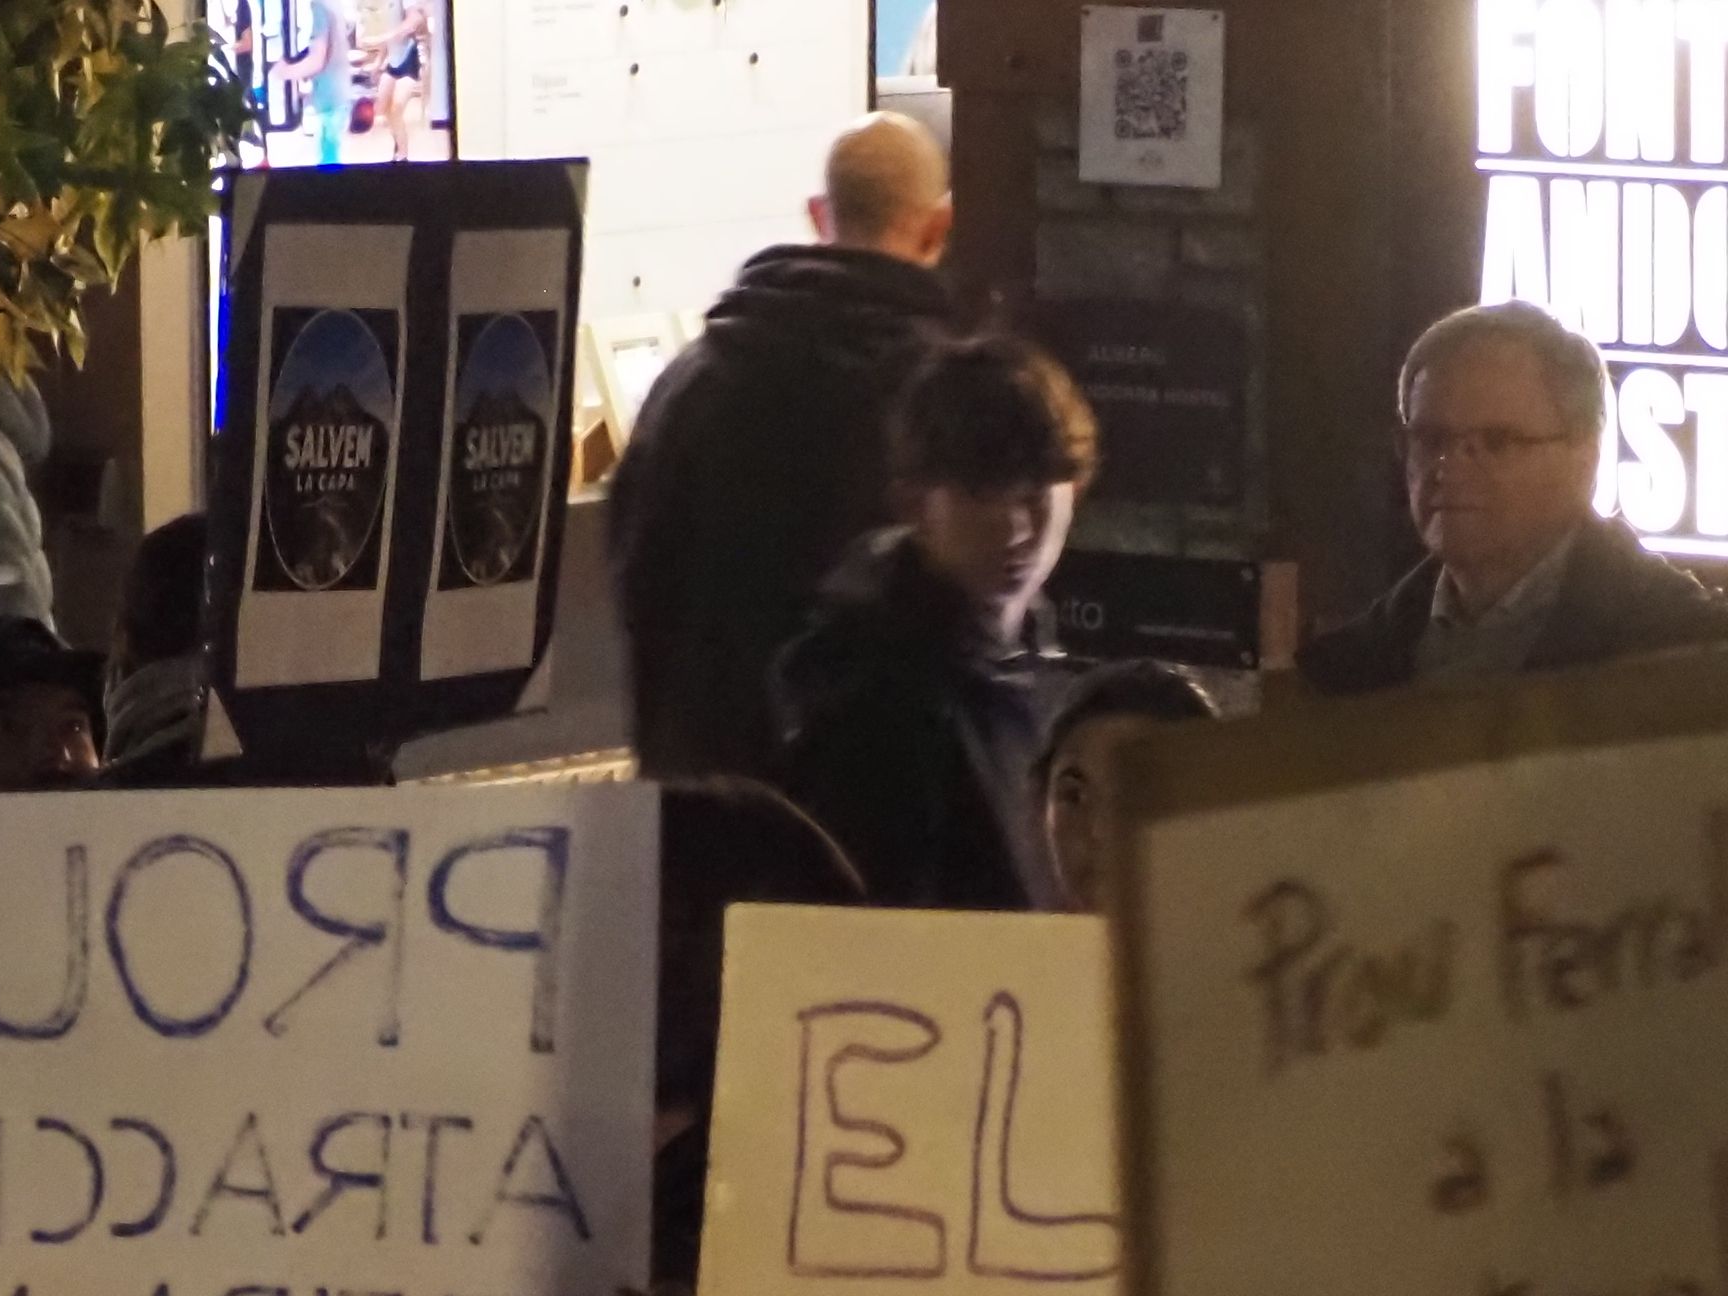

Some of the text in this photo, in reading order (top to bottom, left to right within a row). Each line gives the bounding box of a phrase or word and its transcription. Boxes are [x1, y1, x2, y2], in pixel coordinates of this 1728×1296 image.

[283, 422, 373, 469] SALVEM
[465, 422, 536, 470] SALVEM
[297, 474, 313, 492] LA
[786, 990, 1122, 1280] EL
[1424, 1065, 1642, 1219] a la
